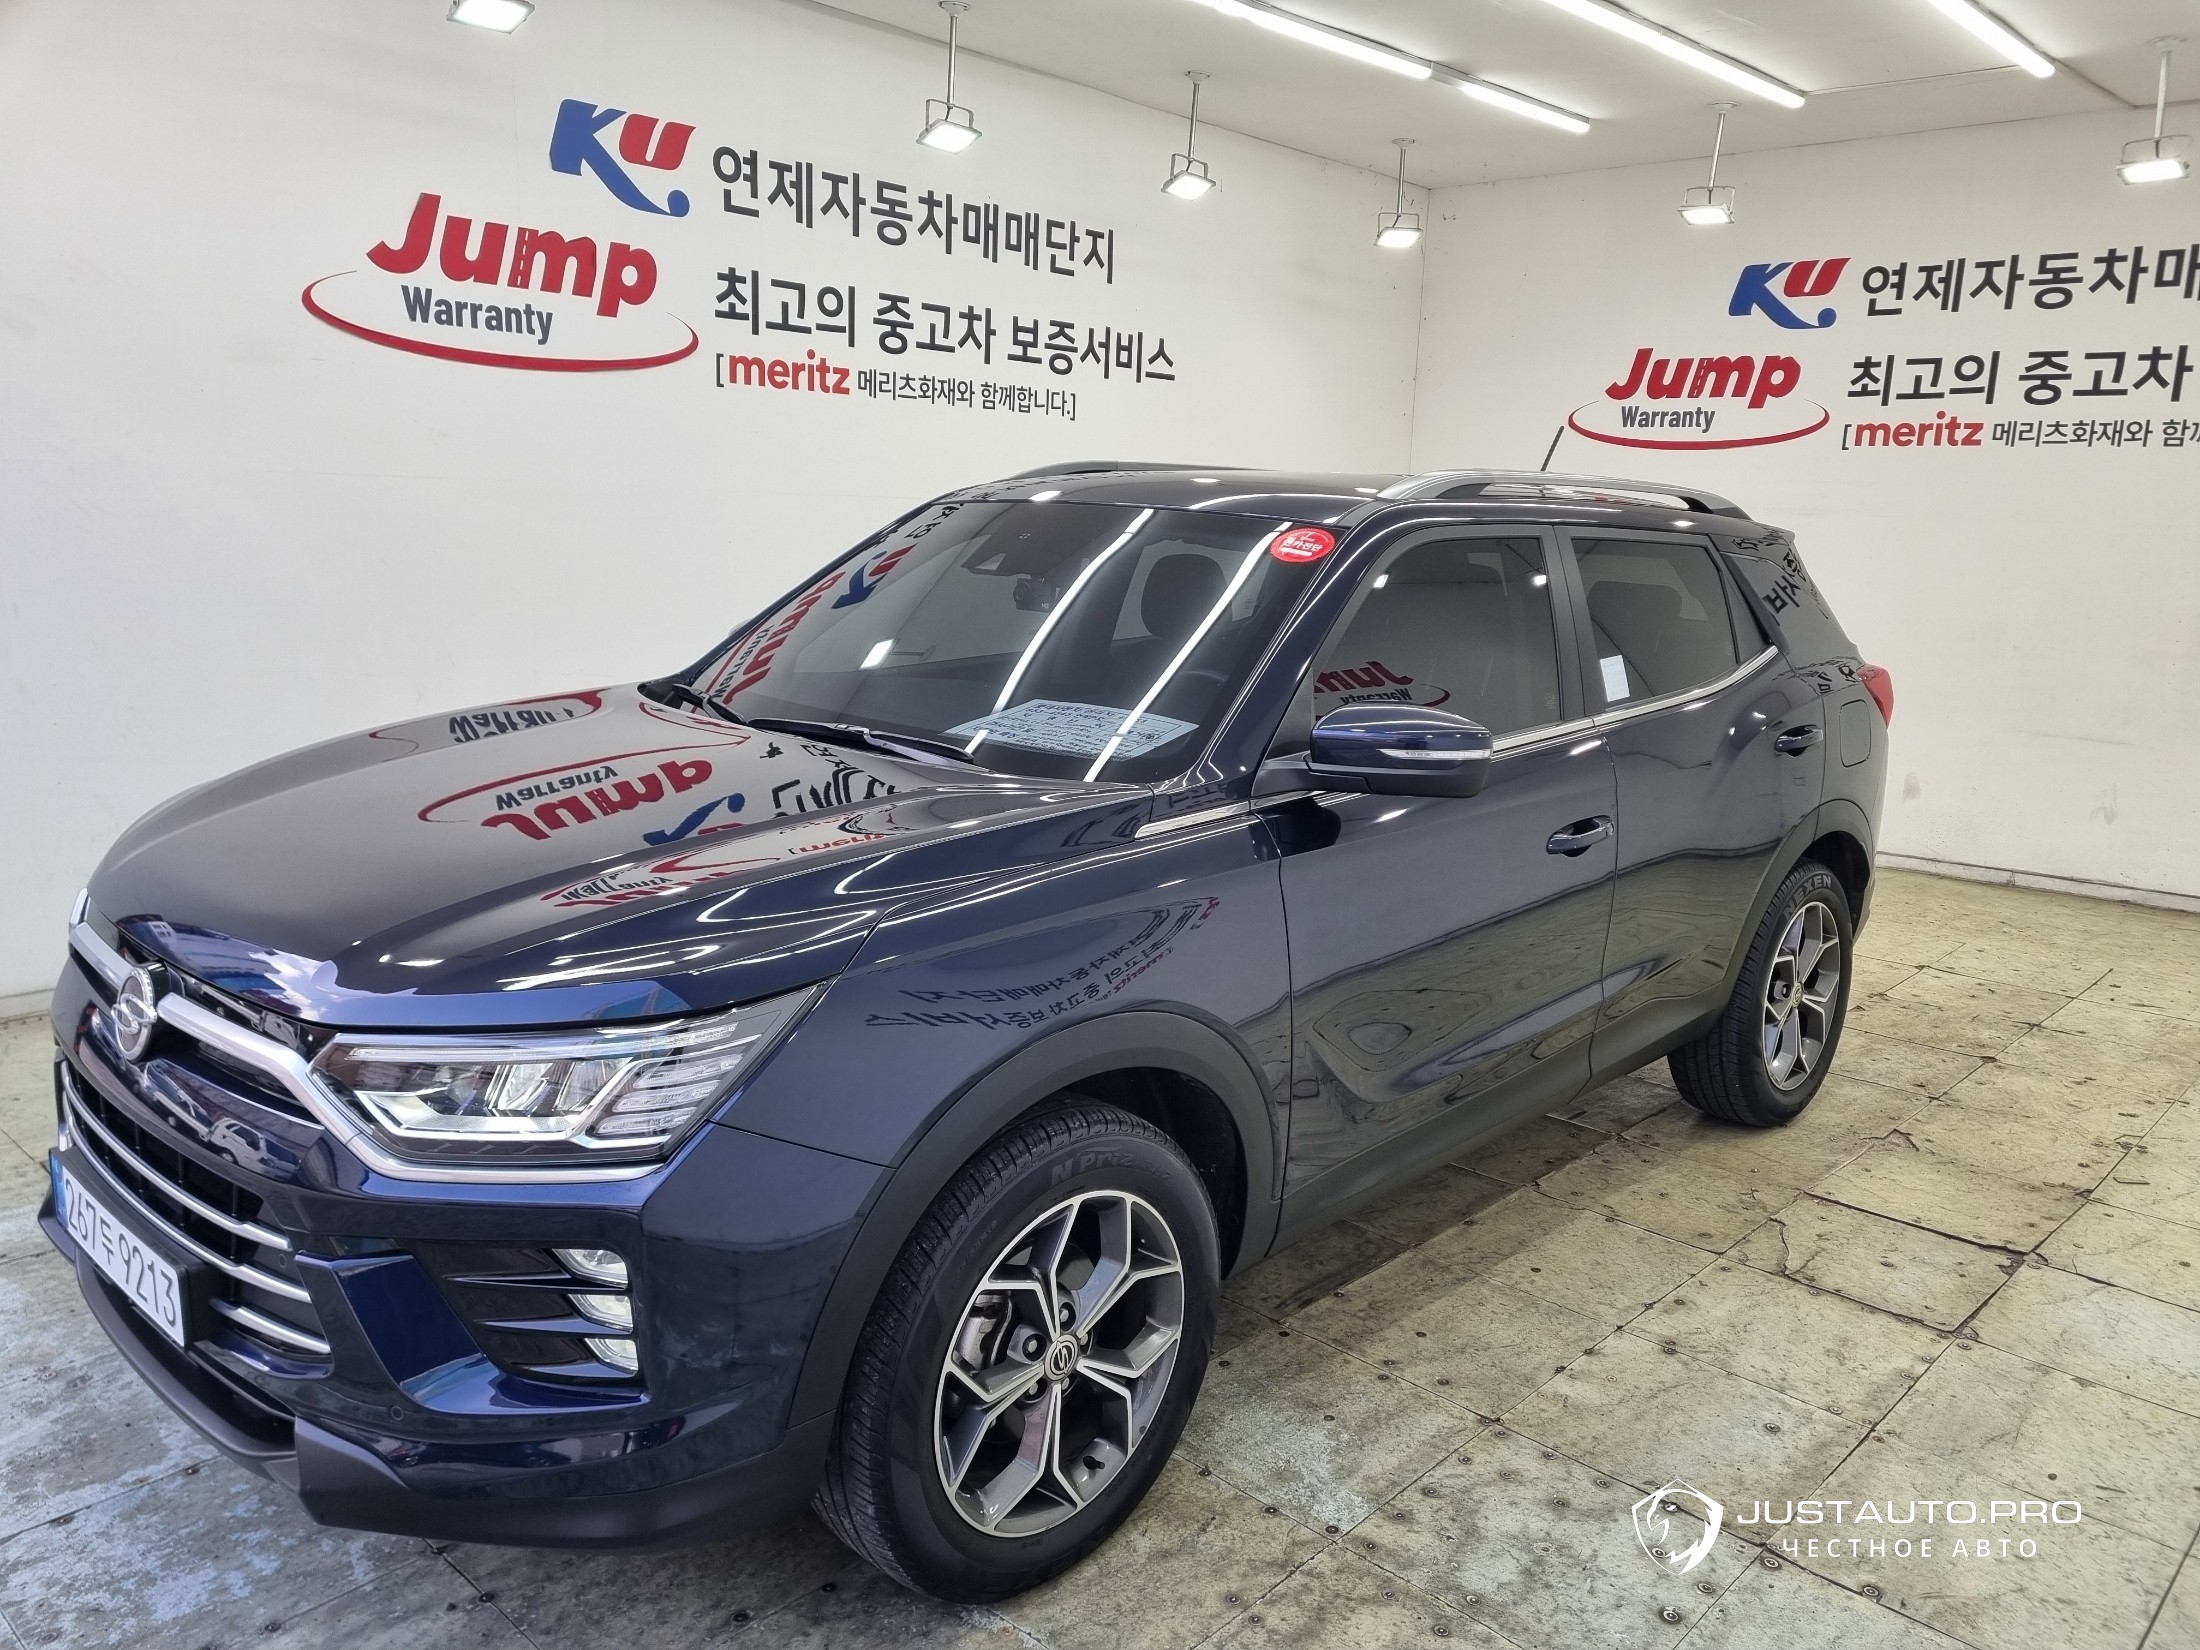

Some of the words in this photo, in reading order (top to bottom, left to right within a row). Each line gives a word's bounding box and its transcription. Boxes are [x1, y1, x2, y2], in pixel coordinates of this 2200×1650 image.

[712, 146, 1115, 284] 연제자동차매매단지
[366, 192, 657, 318] Jump
[1862, 243, 2200, 317] 연제자동차매
[401, 285, 553, 345] Warranty
[714, 267, 855, 348] 최고의
[872, 292, 997, 364] 중고차
[1007, 316, 1176, 384] 보증서비스
[857, 369, 975, 408] 메리츠화재와
[980, 382, 1076, 420] 함께합니다.]
[1605, 348, 1801, 409] Jump
[1847, 351, 2000, 407] 최고의
[2018, 345, 2194, 406] 중고차
[1621, 406, 1716, 433] Warranty
[1992, 419, 2153, 448] 메리츠화재와
[1783, 875, 1832, 921] NEXEN
